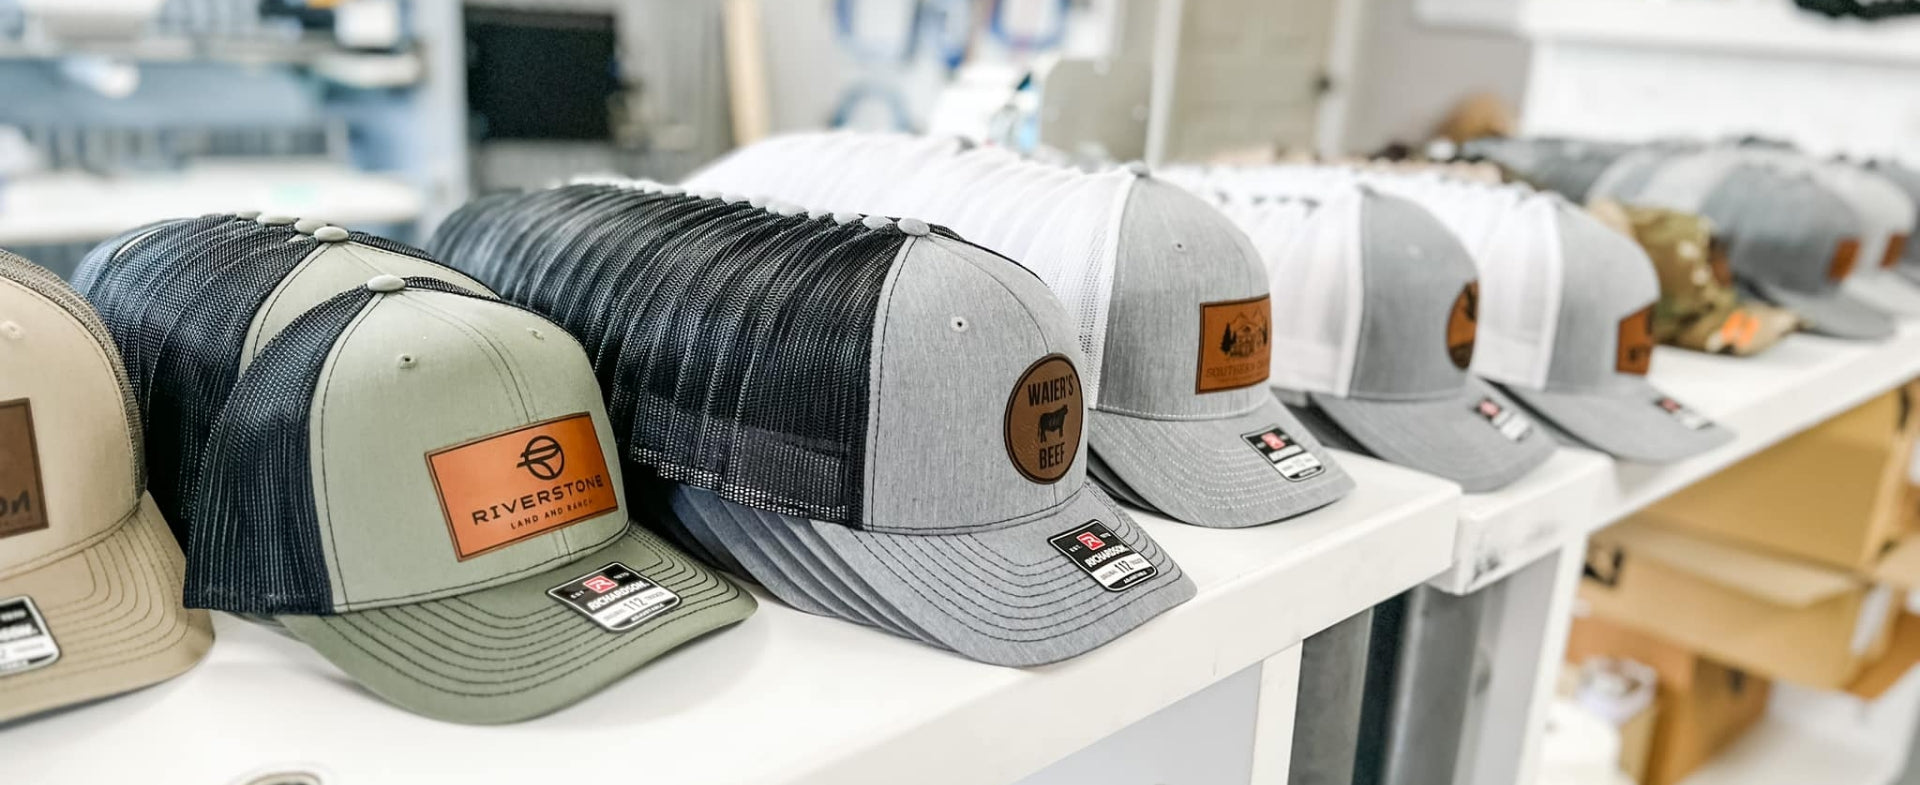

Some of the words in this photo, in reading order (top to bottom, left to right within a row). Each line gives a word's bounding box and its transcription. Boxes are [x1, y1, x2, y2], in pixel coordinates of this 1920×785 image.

[1027, 373, 1074, 407] WAIER'S
[1039, 442, 1066, 470] BEEF
[471, 474, 604, 526] RIVERSTONE
[510, 514, 539, 531] LAND
[544, 506, 564, 520] AND
[1114, 560, 1134, 574] 112
[587, 580, 646, 611] RICHARDSON
[623, 597, 648, 611] 112
